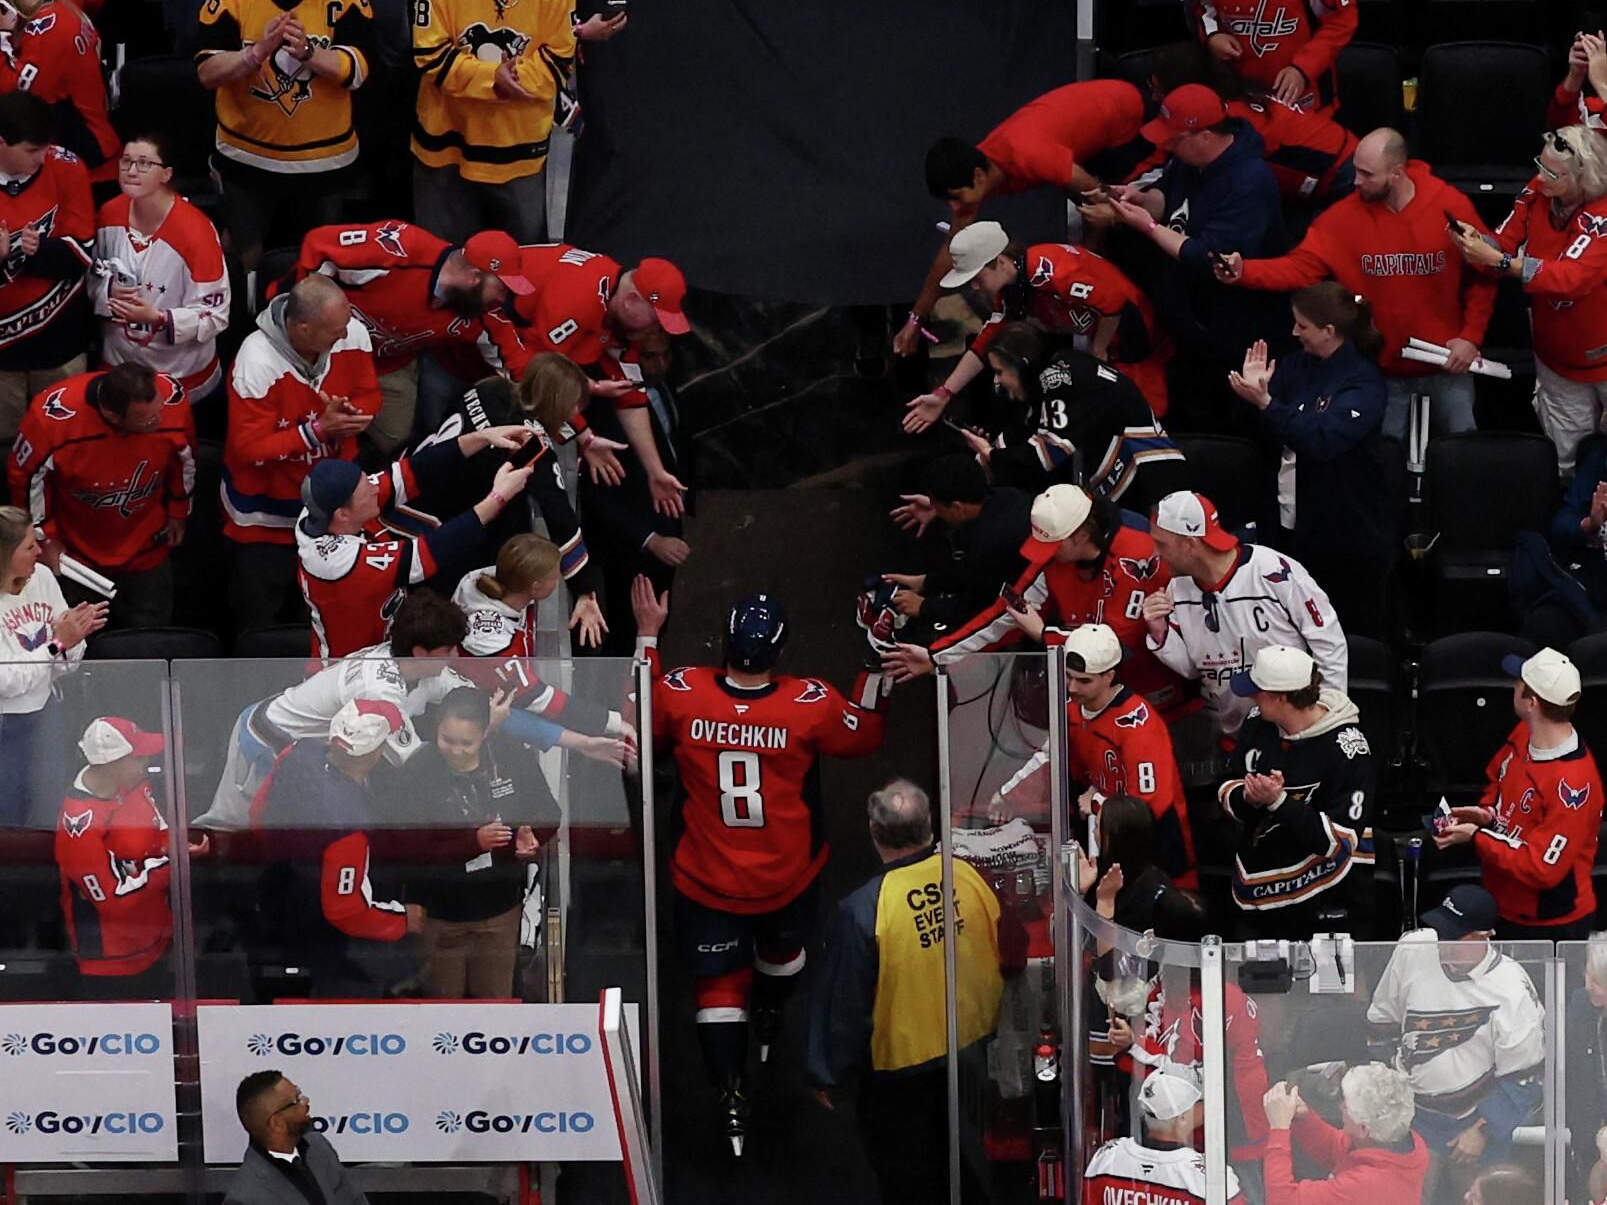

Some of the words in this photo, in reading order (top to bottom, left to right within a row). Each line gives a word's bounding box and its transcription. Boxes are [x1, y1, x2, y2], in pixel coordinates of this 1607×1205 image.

[327, 0, 343, 27] C
[17, 62, 39, 91] 8
[338, 229, 368, 246] 8
[1566, 233, 1592, 260] 8
[1361, 250, 1447, 277] CAPITALS
[548, 318, 580, 345] 8
[1039, 399, 1068, 429] 43
[12, 431, 34, 467] 19
[1125, 589, 1146, 620] 8
[1253, 606, 1270, 632] C
[690, 718, 788, 749] OVECHKIN
[717, 751, 765, 828] 8
[1138, 761, 1157, 794] 8
[1349, 789, 1366, 821] 8
[1520, 787, 1535, 814] C
[1542, 833, 1569, 865] 8
[82, 874, 107, 902] 8
[337, 866, 356, 895] 8
[1252, 859, 1338, 899] CAPITALS
[907, 882, 956, 911] CS
[914, 900, 961, 932] EVET
[918, 911, 967, 948] STAF
[697, 936, 739, 953] CCM
[31, 1032, 161, 1056] GovCIO
[277, 1032, 407, 1056] GovCIO
[461, 1031, 592, 1055] GovCIO
[35, 1111, 164, 1134] GovCIO
[312, 1112, 410, 1134] ovCIO
[465, 1110, 595, 1133] GovCIO
